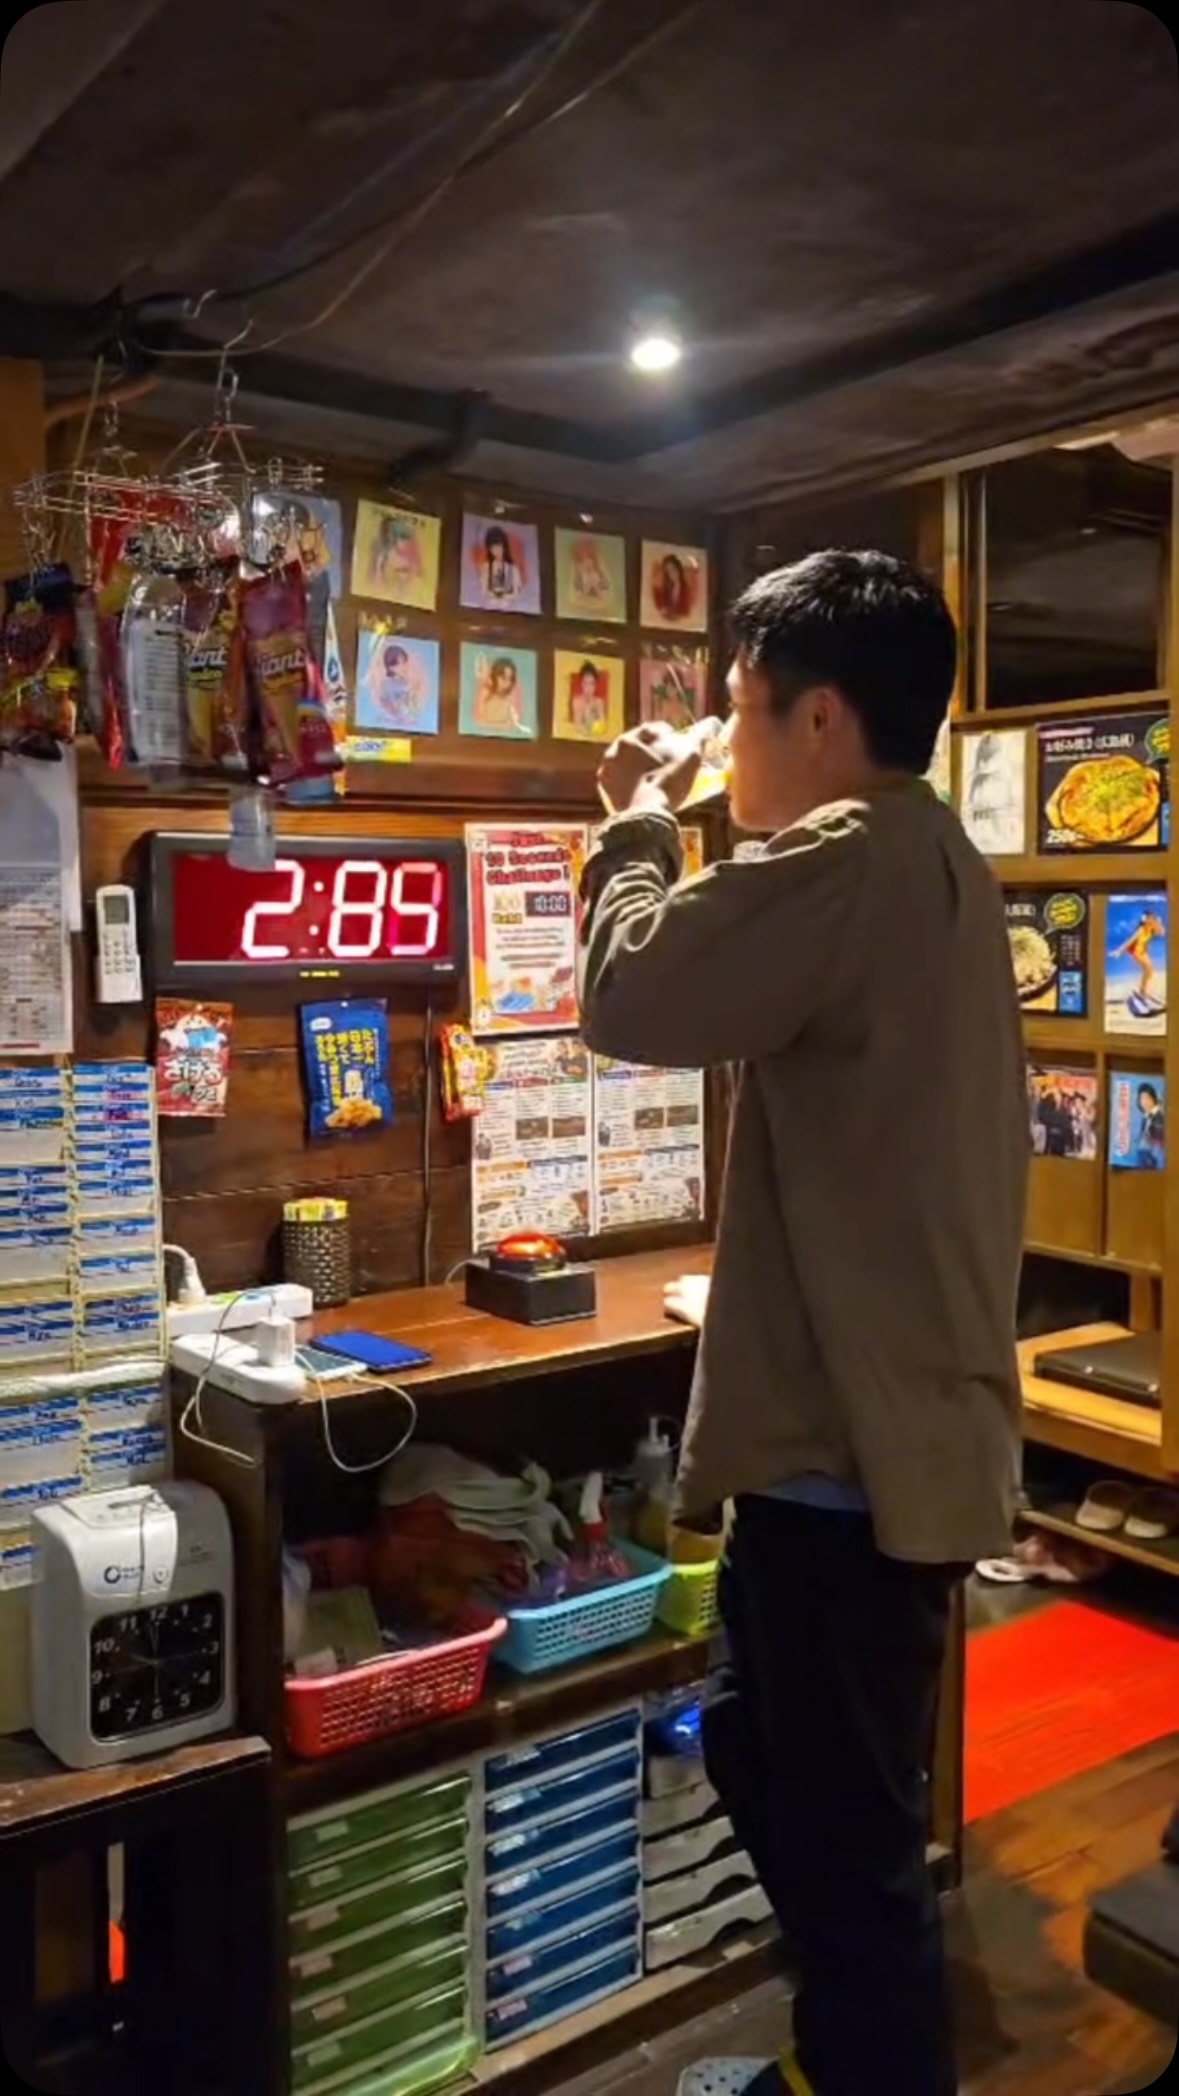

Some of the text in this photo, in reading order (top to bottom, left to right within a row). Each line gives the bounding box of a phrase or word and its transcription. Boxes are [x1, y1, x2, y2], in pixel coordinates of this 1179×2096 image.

[150, 1606, 168, 1620] 12
[182, 1603, 189, 1617] 1
[120, 1617, 137, 1632] 11
[203, 1613, 213, 1628] 2
[94, 1637, 115, 1655] 10
[209, 1641, 219, 1654] 3
[91, 1669, 103, 1685] 9
[198, 1670, 211, 1684] 4
[98, 1696, 111, 1712] 8
[126, 1706, 137, 1722] 7
[151, 1705, 164, 1719] 6
